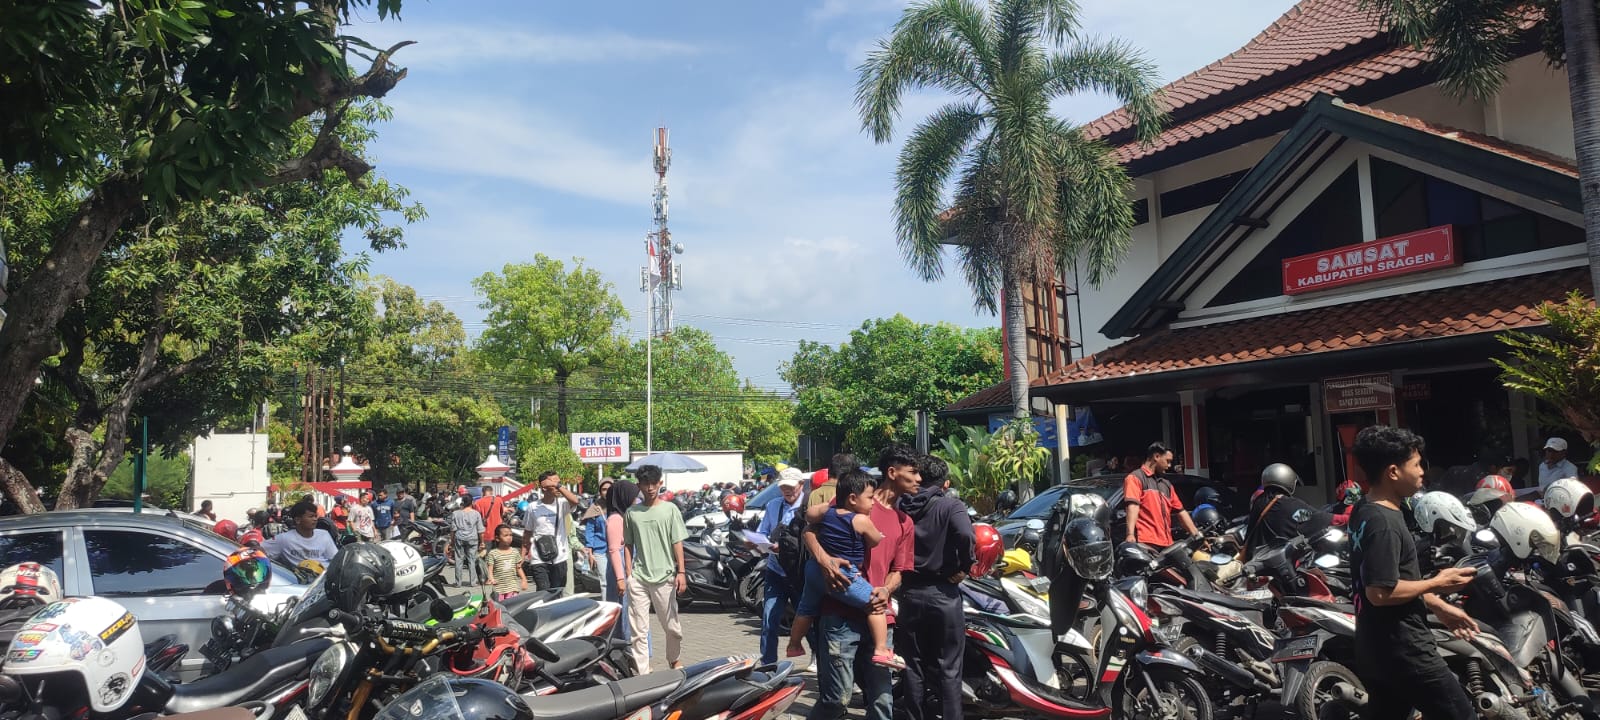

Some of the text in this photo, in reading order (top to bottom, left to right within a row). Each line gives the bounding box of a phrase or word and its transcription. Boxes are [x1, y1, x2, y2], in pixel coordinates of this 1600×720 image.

[1317, 240, 1409, 272] SAMSAT
[1298, 252, 1435, 286] KABUPATEN SRAGEN
[579, 436, 621, 446] CEK FISIK
[585, 447, 616, 457] GRATIS
[399, 566, 415, 576] KYT
